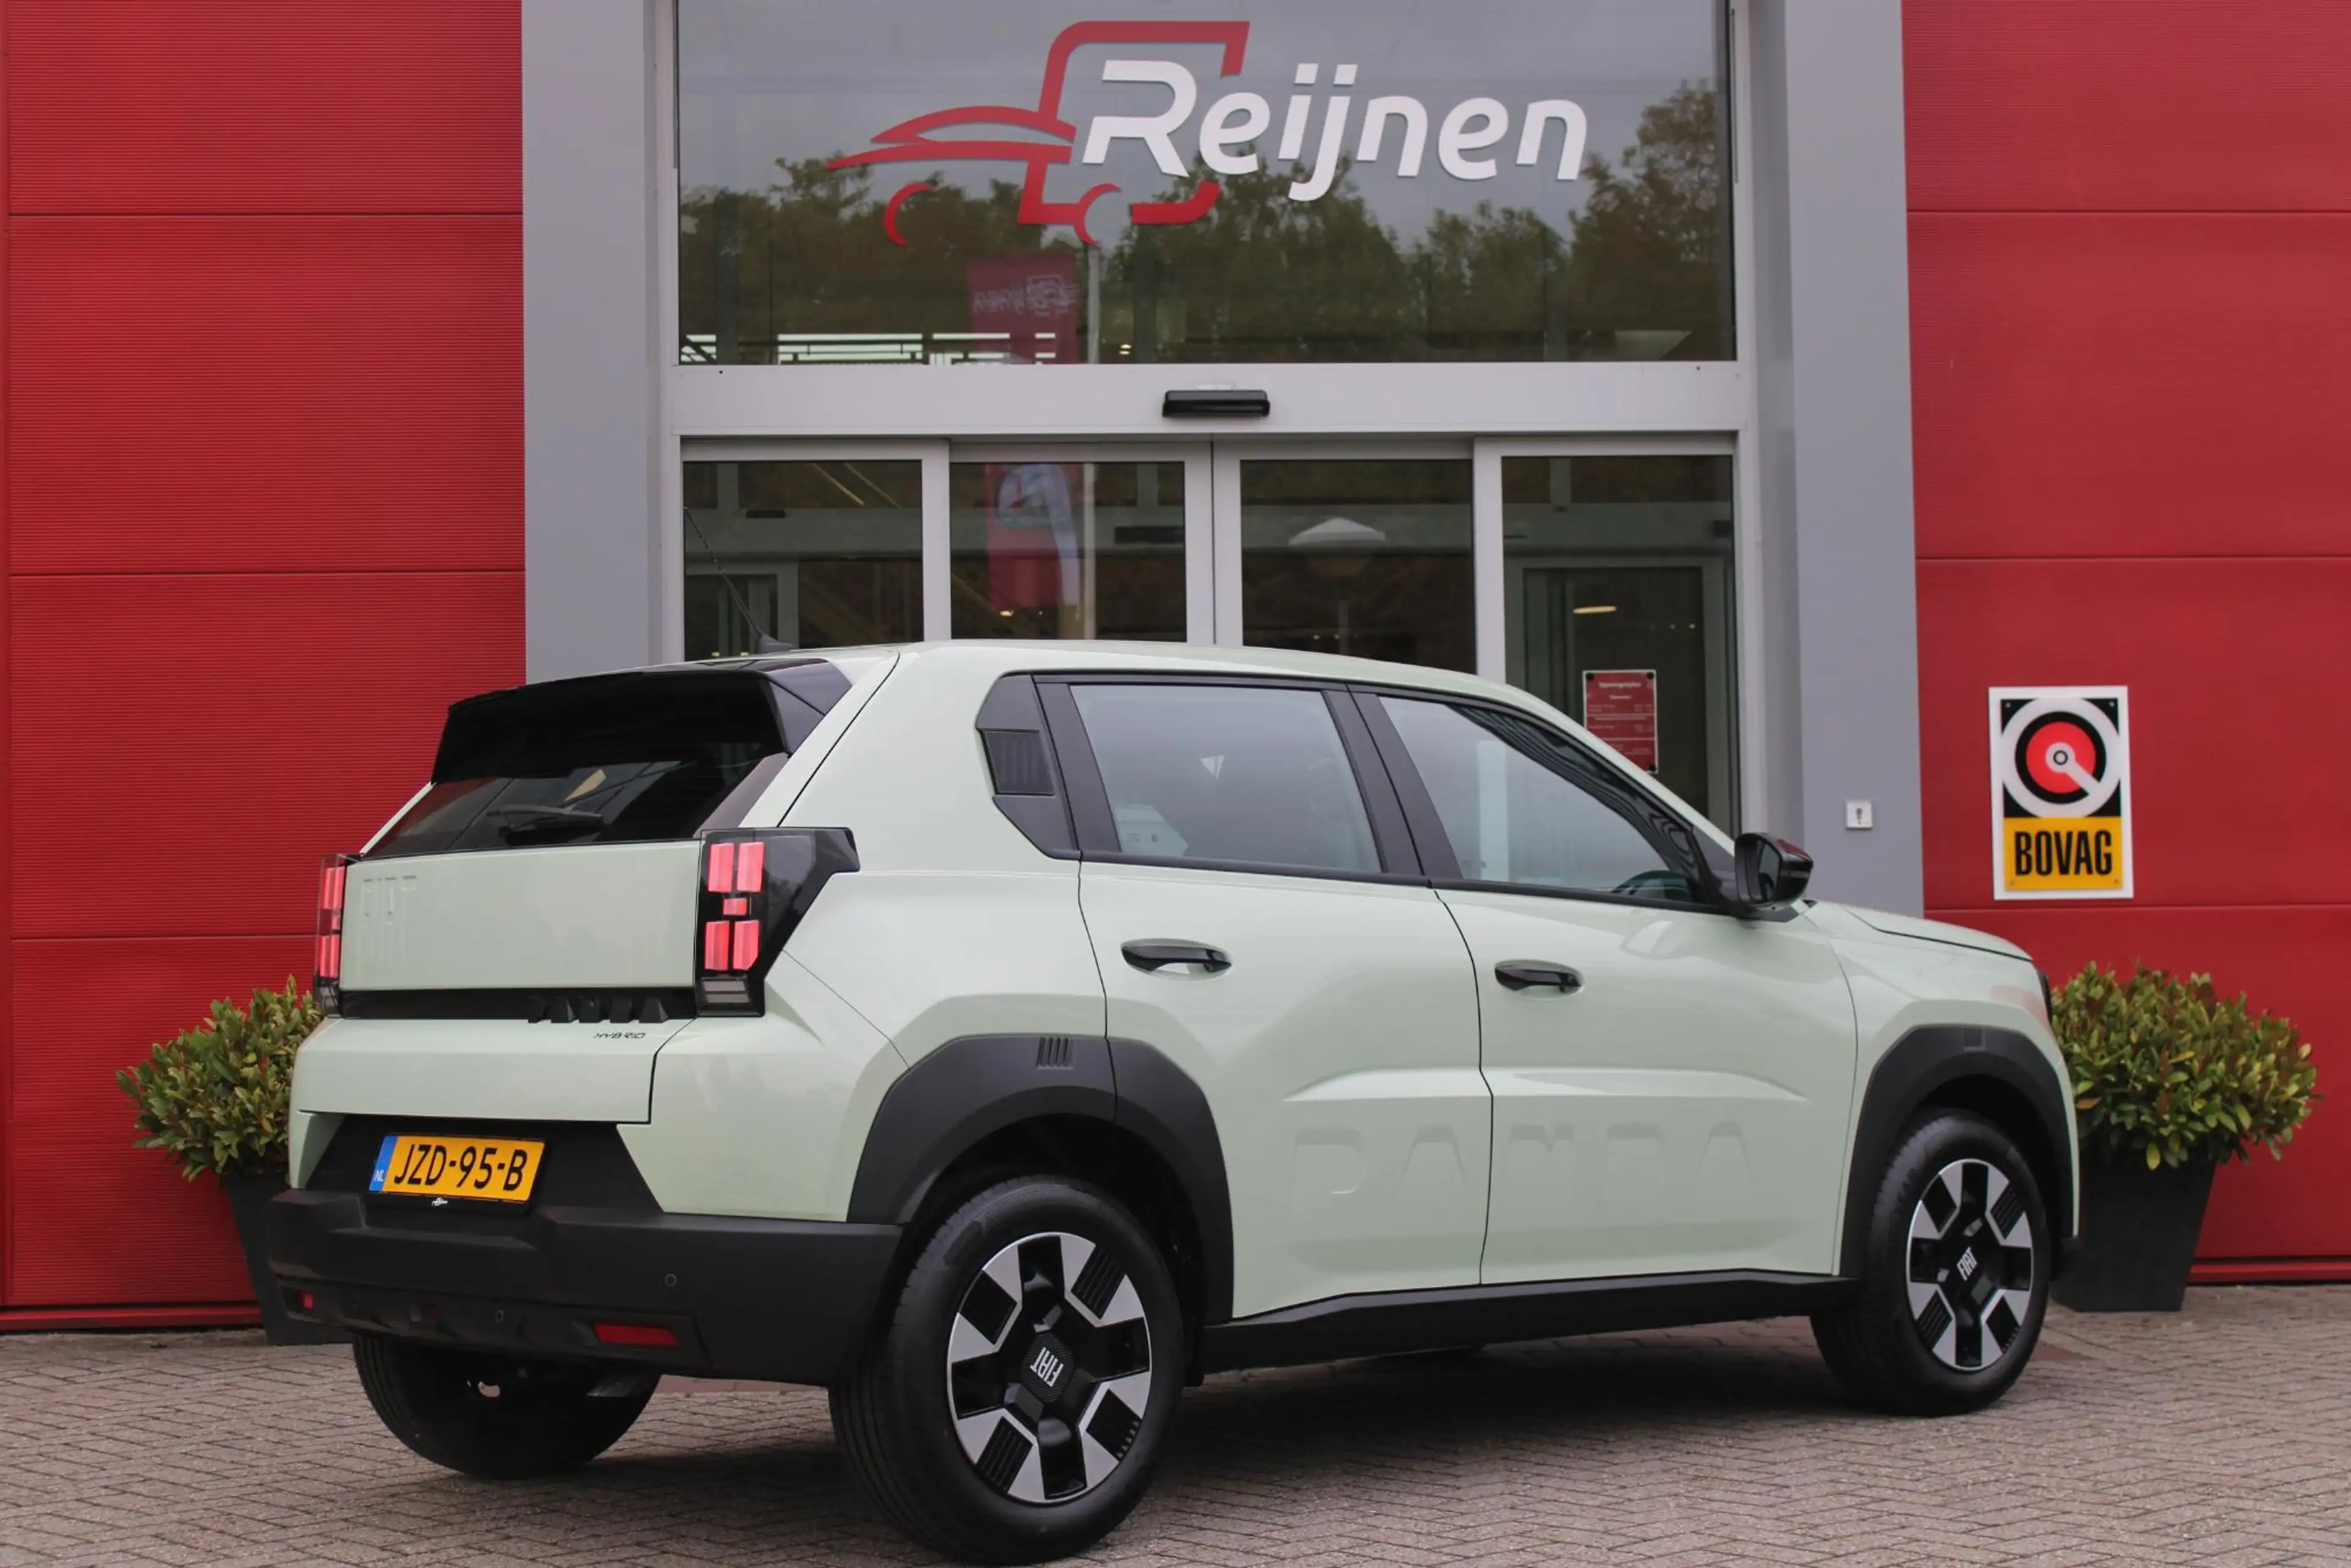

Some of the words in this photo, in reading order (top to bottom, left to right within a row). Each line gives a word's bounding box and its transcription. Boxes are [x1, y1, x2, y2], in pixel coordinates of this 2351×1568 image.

[1082, 58, 1588, 201] Reijnen
[2014, 830, 2113, 876] BOVAG
[394, 1143, 528, 1191] JZD-95-B
[1957, 1245, 1978, 1281] FIAT
[1029, 1346, 1064, 1387] FIAT
